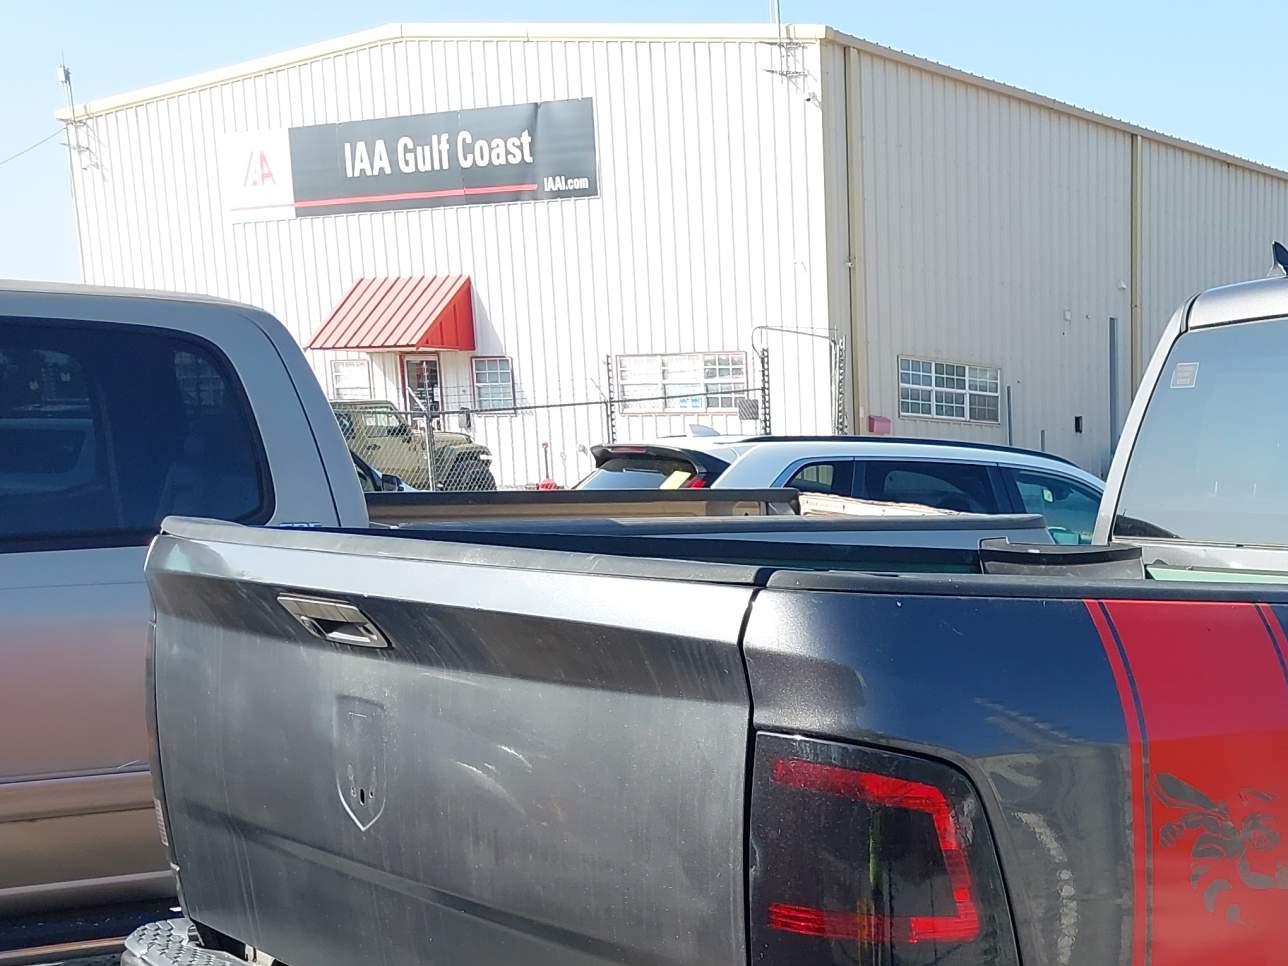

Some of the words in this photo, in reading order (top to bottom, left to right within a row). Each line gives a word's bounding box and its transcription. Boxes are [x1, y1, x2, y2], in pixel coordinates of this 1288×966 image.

[344, 139, 392, 178] IAA
[397, 133, 450, 174] Gulf
[457, 129, 534, 169] Coast
[543, 175, 589, 192] IAAI.com
